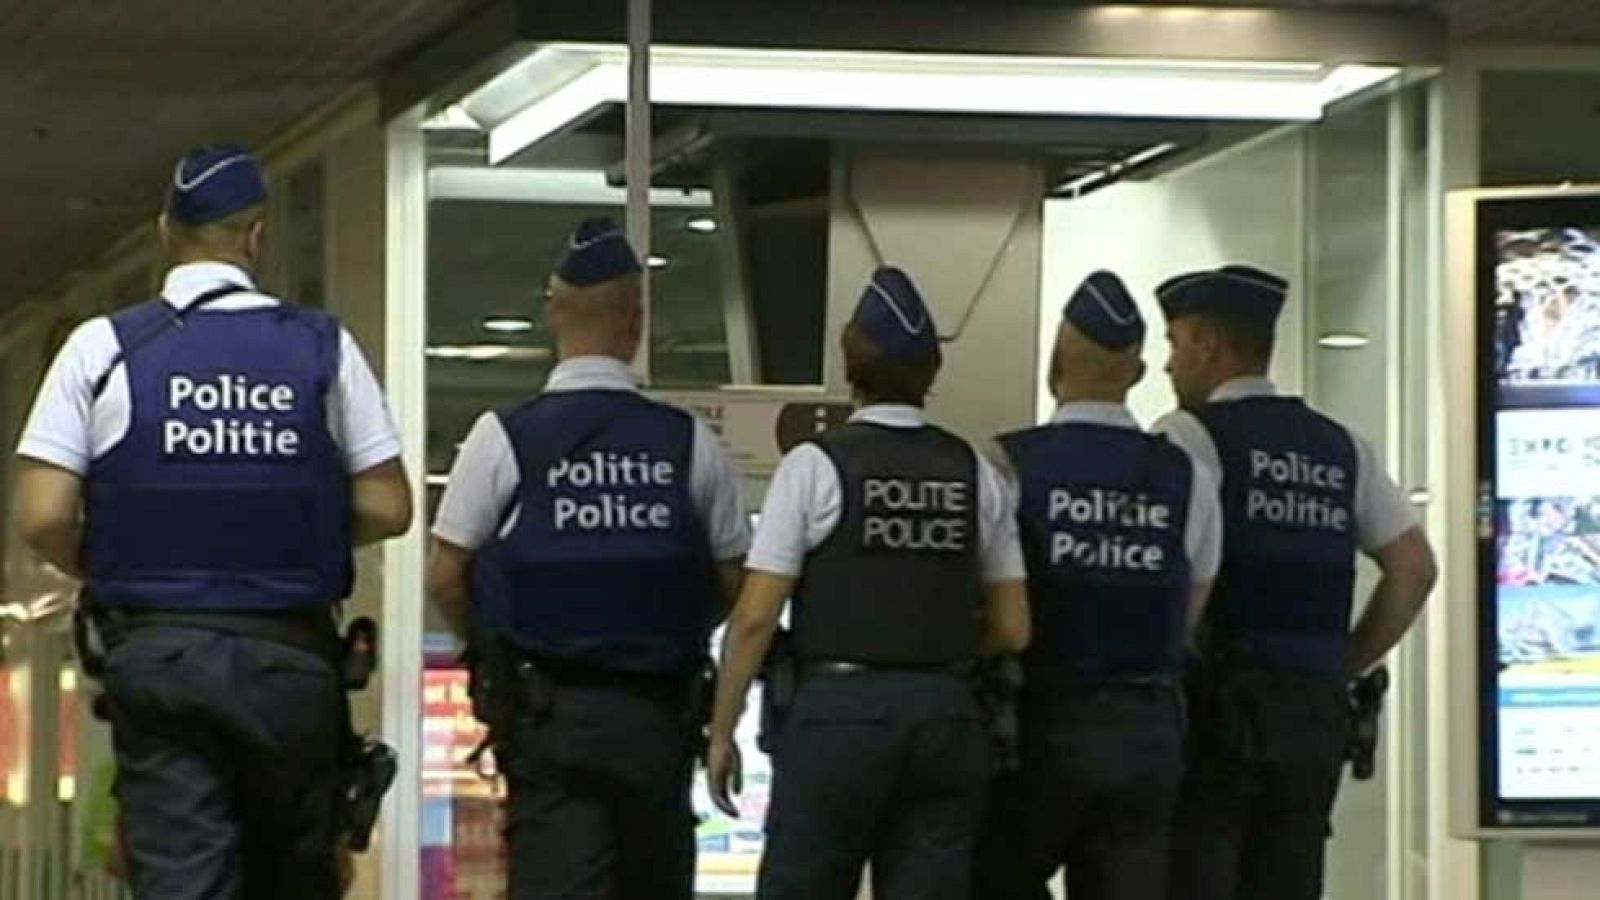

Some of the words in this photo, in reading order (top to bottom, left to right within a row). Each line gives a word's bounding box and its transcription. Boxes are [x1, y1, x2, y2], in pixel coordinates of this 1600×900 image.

[169, 375, 295, 410] Police
[164, 419, 299, 454] Politie
[1251, 450, 1345, 489] Police
[555, 493, 670, 530] Police
[864, 479, 967, 511] POLITIE
[1247, 490, 1348, 531] Politie
[863, 516, 967, 550] POLICE
